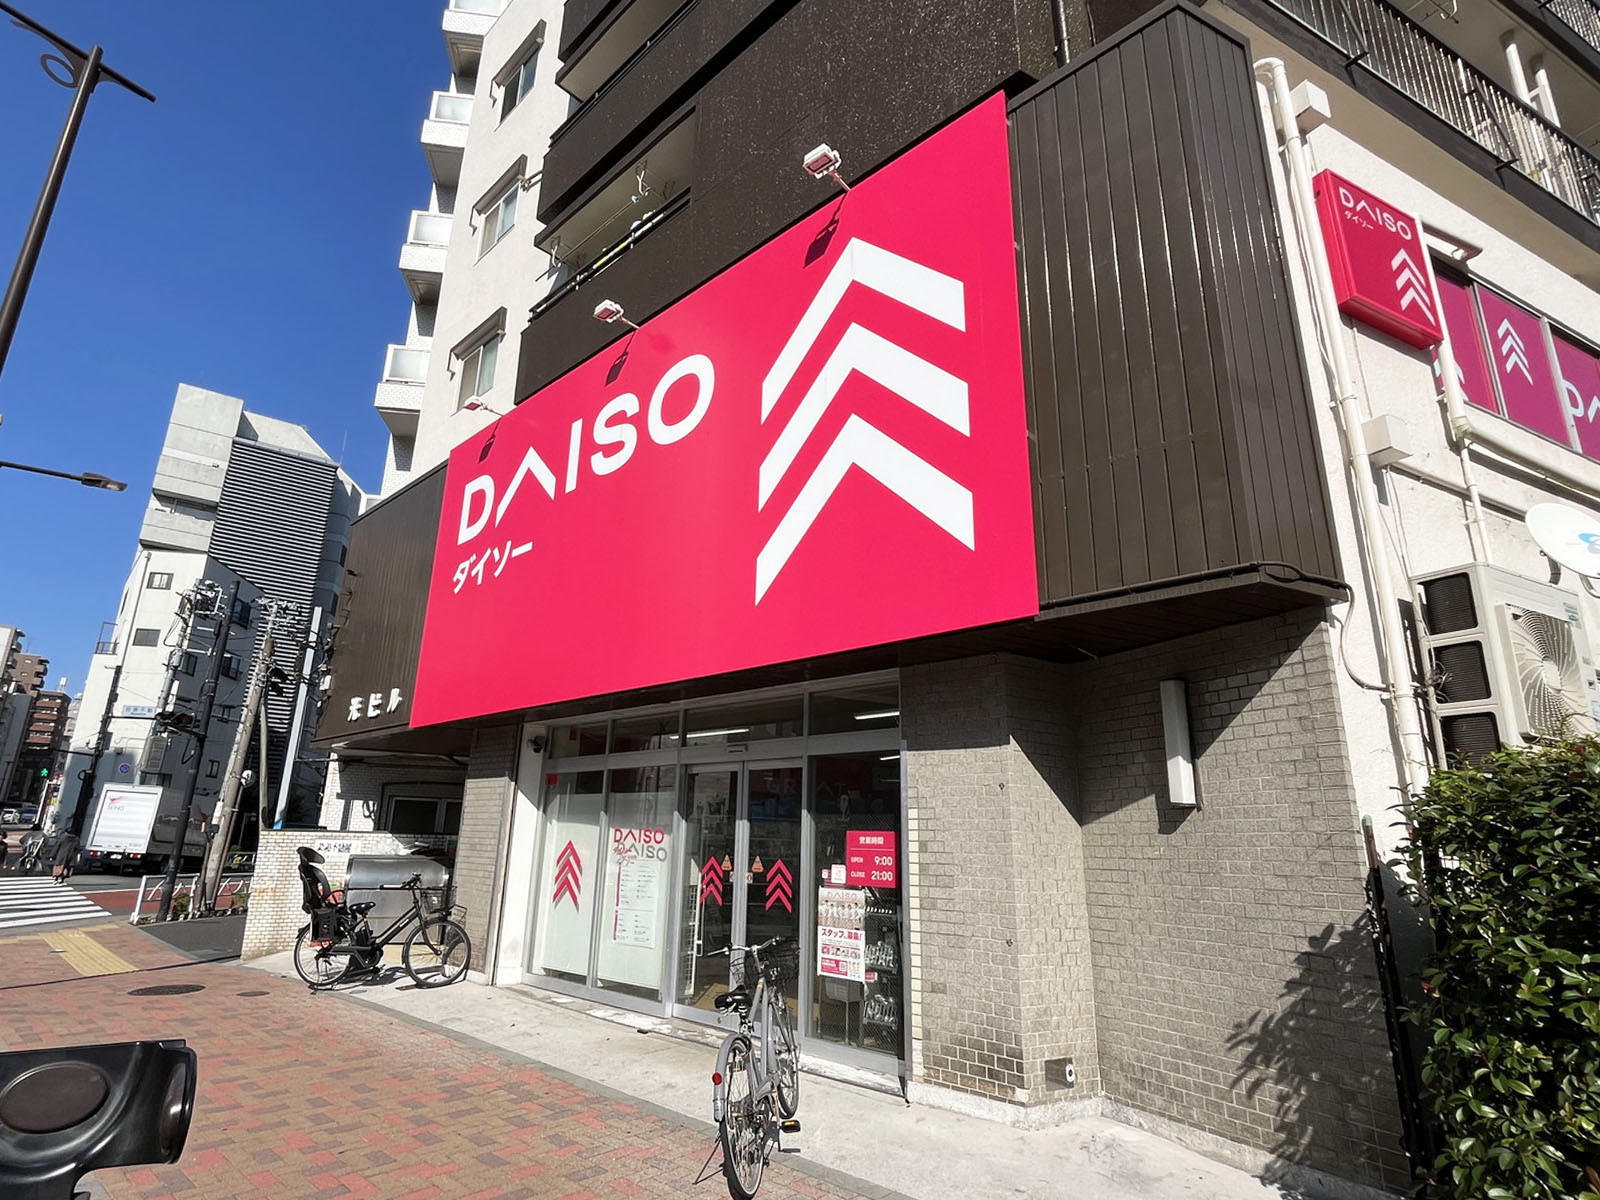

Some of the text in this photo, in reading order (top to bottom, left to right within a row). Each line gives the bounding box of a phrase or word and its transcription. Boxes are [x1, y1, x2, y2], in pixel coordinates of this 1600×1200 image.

[1338, 186, 1412, 241] DAISO
[1344, 210, 1374, 230] ダイソー
[457, 353, 715, 546] DAISO
[452, 540, 533, 595] ダイソー
[613, 828, 665, 844] DAISO
[859, 836, 884, 845] 営業時間
[874, 856, 893, 866] 9:00
[871, 870, 893, 881] 21:00
